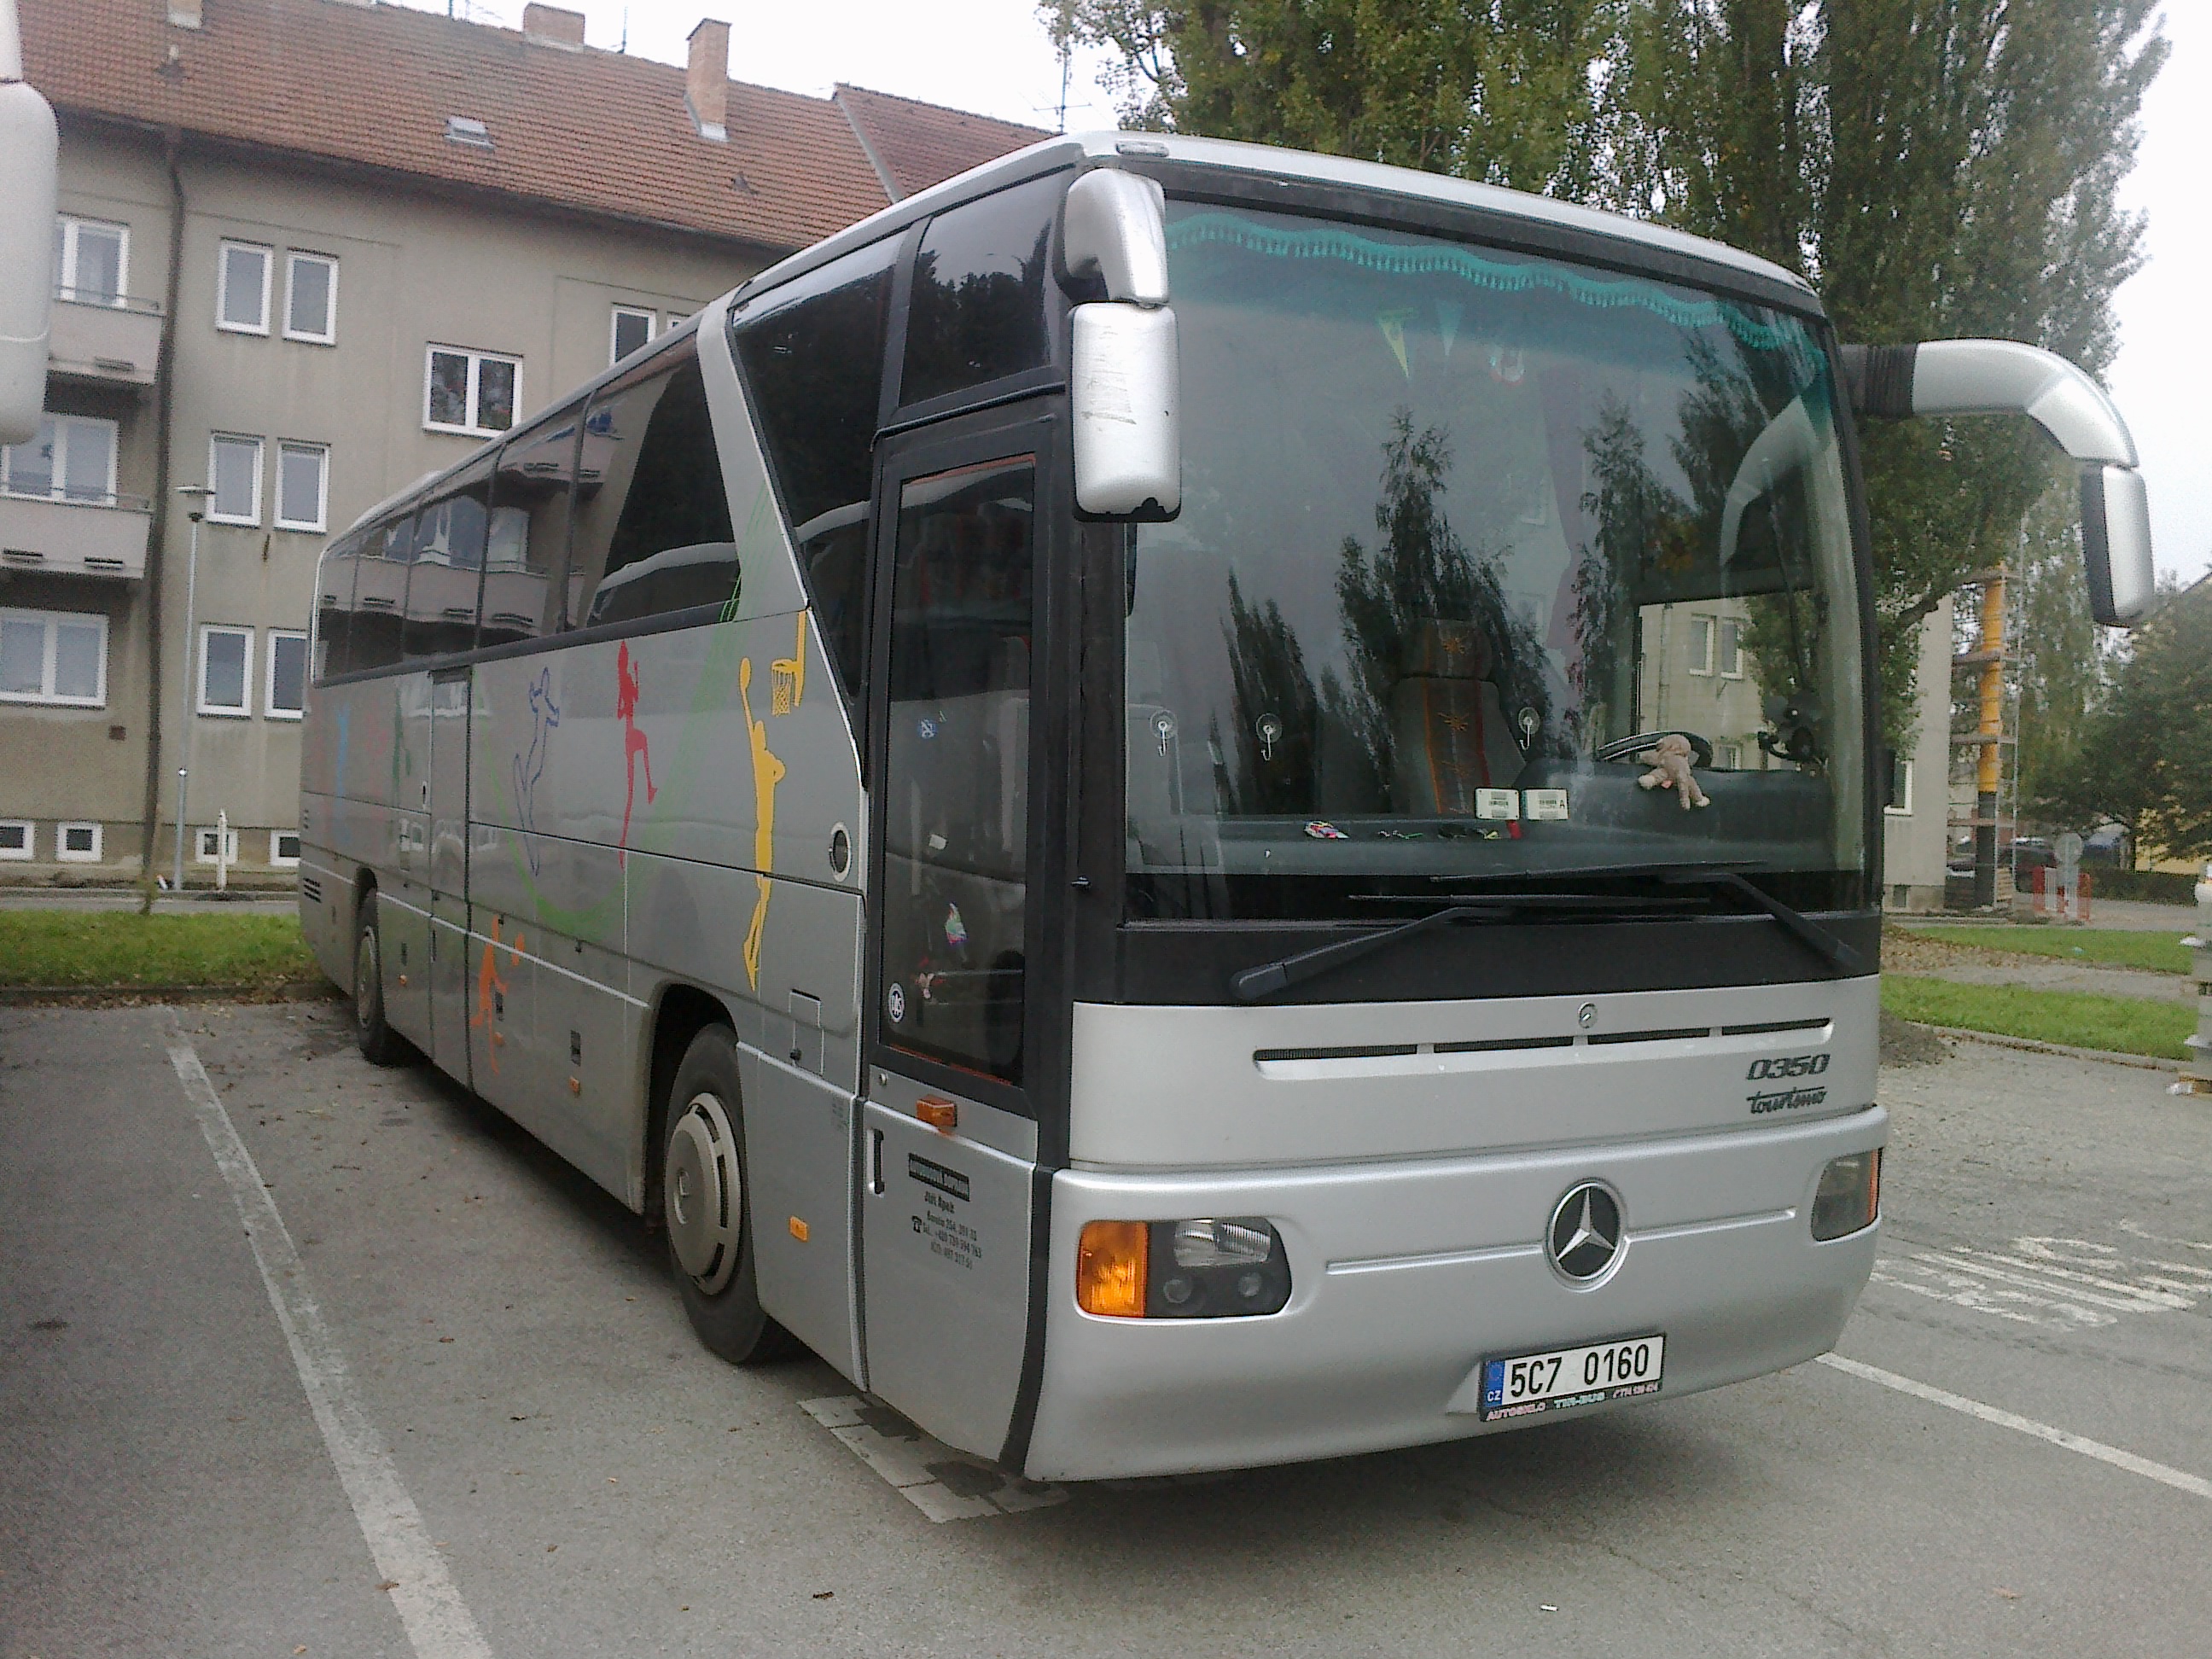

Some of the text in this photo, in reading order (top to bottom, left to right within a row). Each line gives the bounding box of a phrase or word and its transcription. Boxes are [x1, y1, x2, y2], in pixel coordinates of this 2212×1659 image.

[1511, 1357, 1563, 1398] 5C7
[1584, 1343, 1649, 1385] 0160
[1487, 1389, 1501, 1402] CZ
